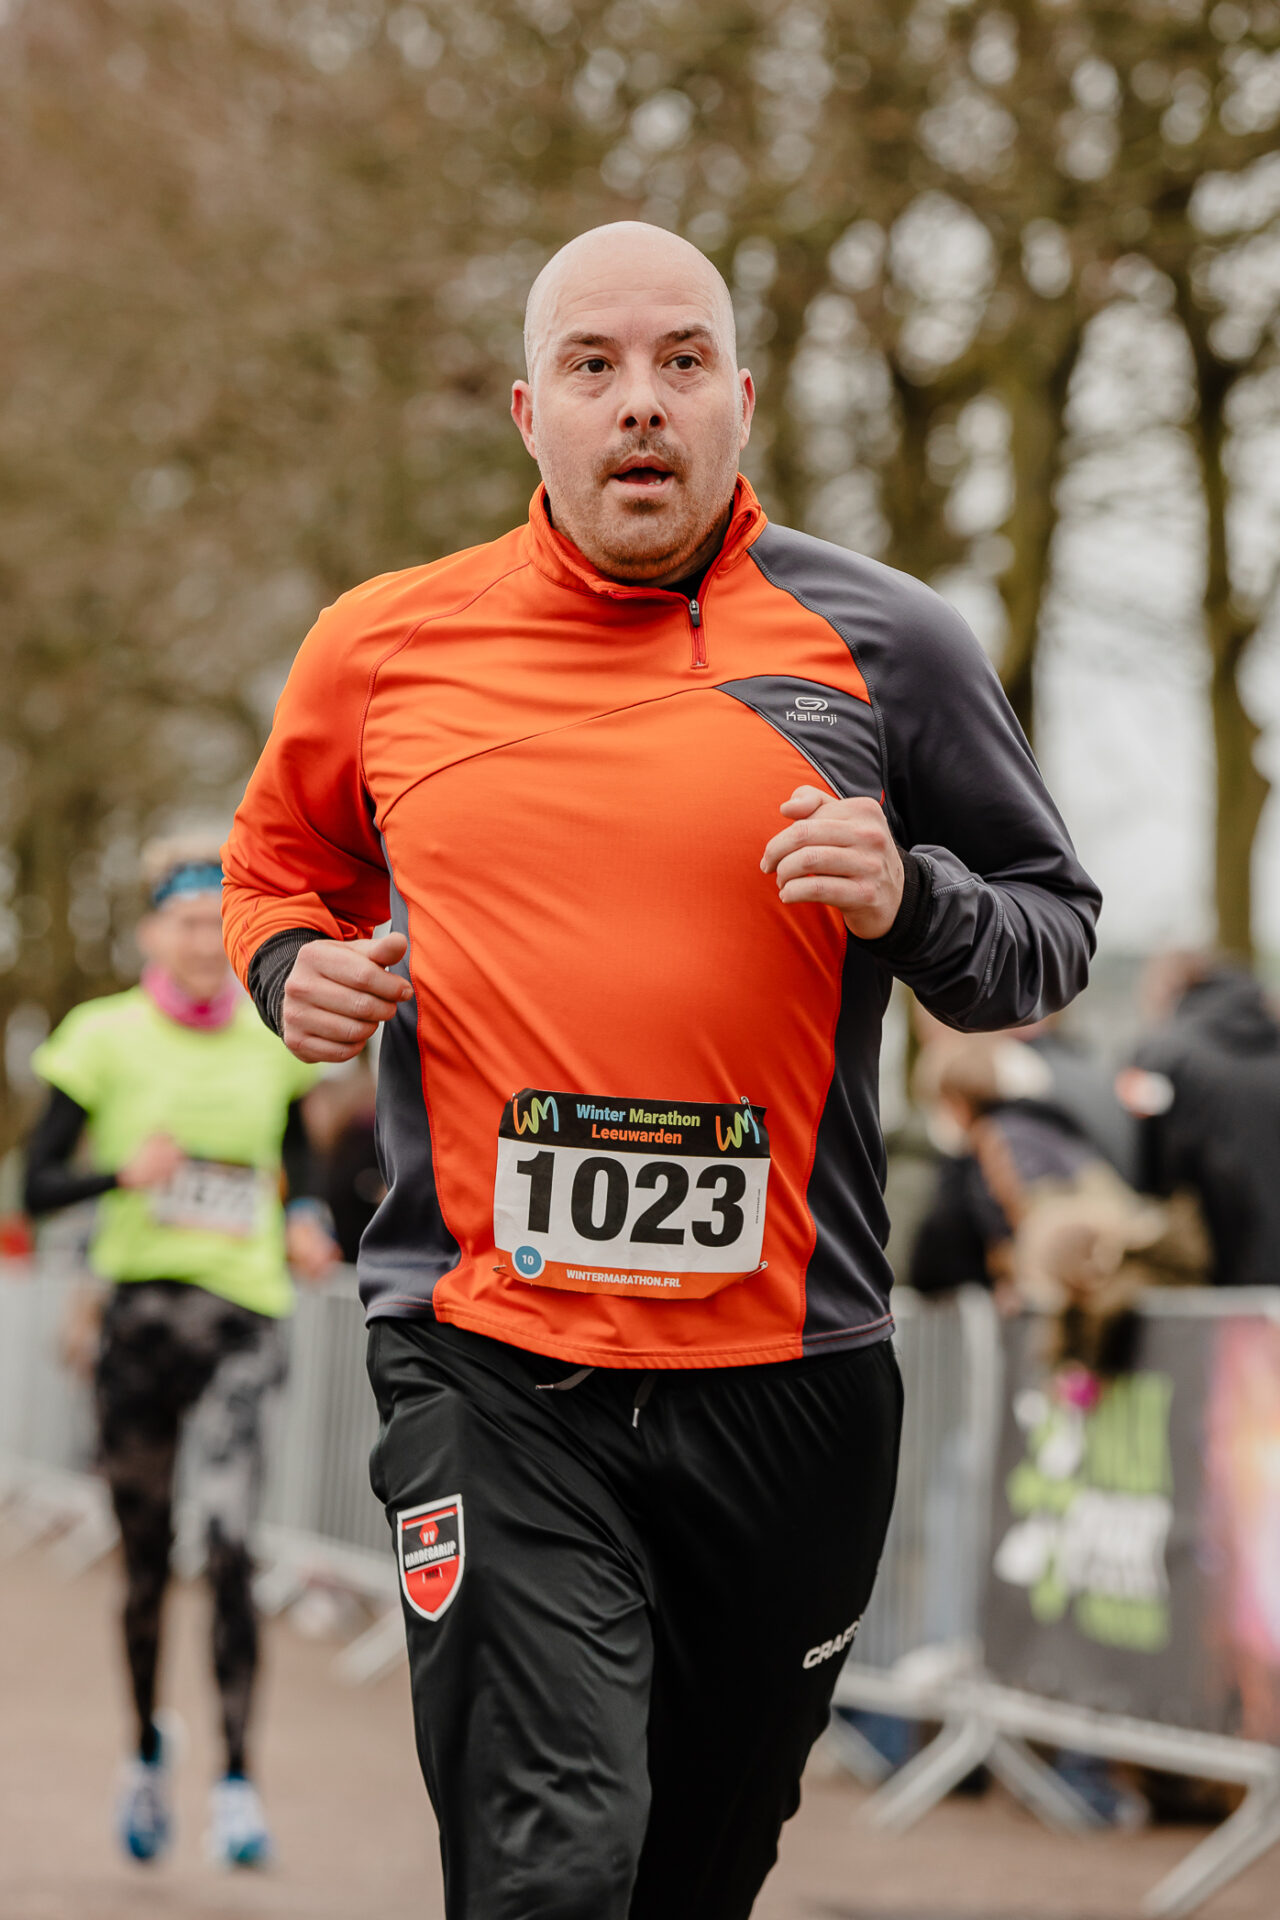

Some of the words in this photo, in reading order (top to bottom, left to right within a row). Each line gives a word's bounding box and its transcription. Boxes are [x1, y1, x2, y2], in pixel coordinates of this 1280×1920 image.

[786, 711, 838, 726] Kalenji
[576, 1103, 626, 1123] Winter
[629, 1108, 701, 1127] Marathon
[591, 1124, 682, 1144] Leeuwarden
[516, 1150, 747, 1248] 1023
[522, 1254, 534, 1265] 10
[566, 1269, 682, 1288] WINTERMARATHON.FRL
